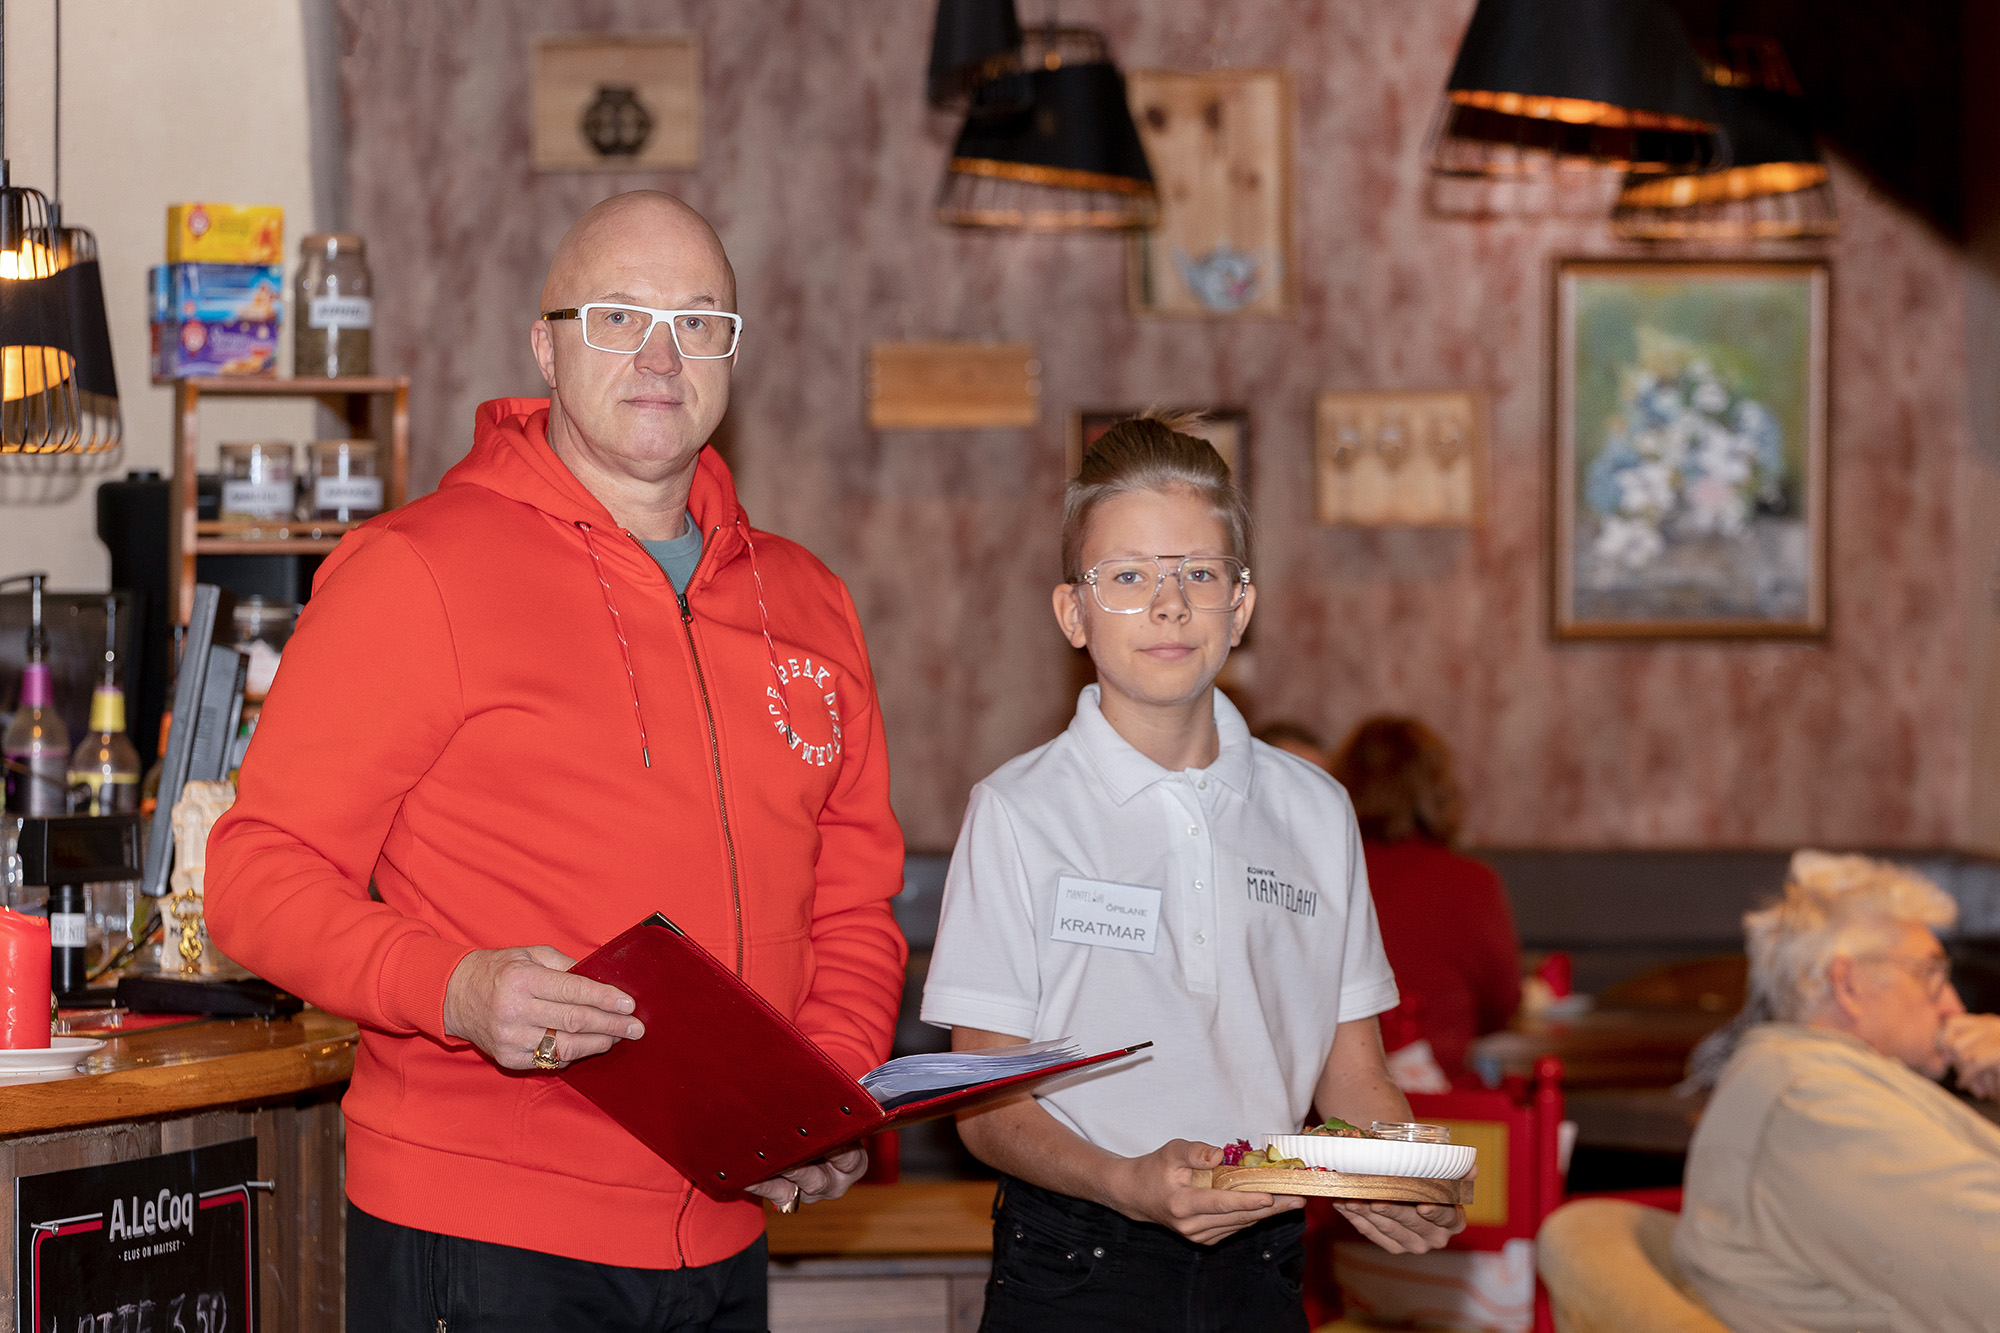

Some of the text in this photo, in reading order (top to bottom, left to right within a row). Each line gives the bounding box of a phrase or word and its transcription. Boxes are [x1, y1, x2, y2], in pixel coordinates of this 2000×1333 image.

[777, 657, 831, 689] PEAK
[766, 685, 842, 767] PERFORMANCE
[1060, 917, 1147, 942] KRATMAR
[123, 1240, 181, 1262] ELUS ON MAITSET
